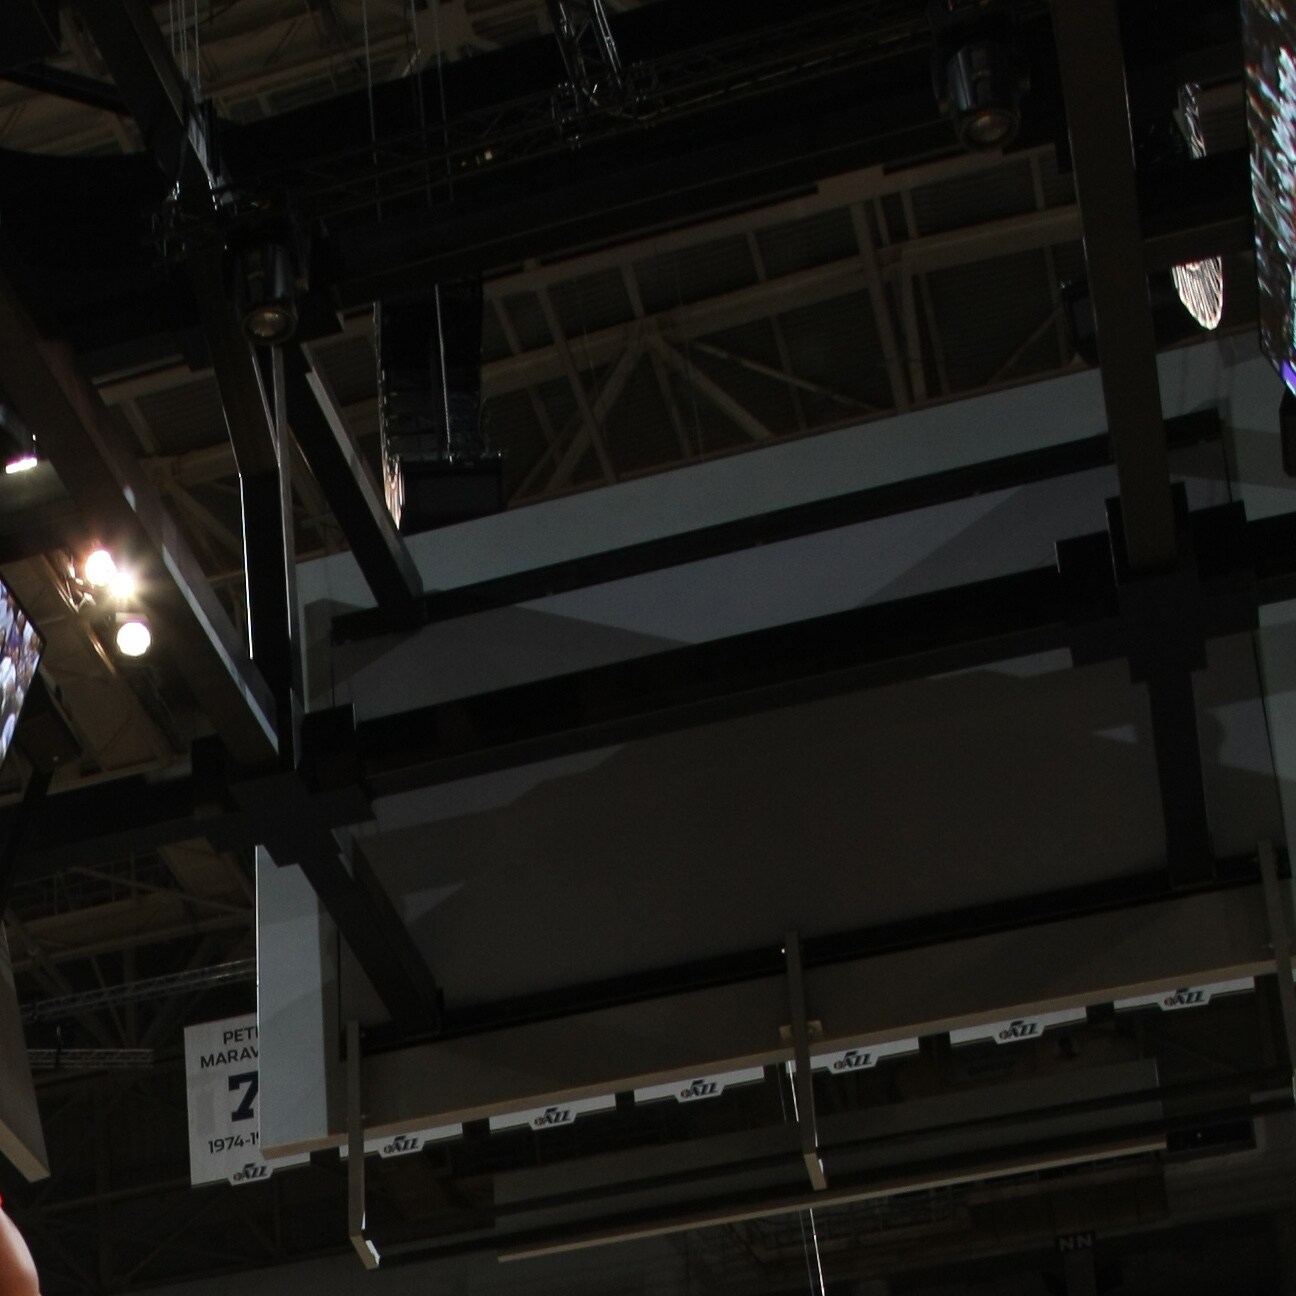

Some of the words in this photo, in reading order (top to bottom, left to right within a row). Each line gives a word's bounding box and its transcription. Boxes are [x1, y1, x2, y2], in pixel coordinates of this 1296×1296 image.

[200, 1045, 259, 1068] MARAV
[228, 1070, 259, 1122] 7
[208, 1132, 259, 1154] 1974-1
